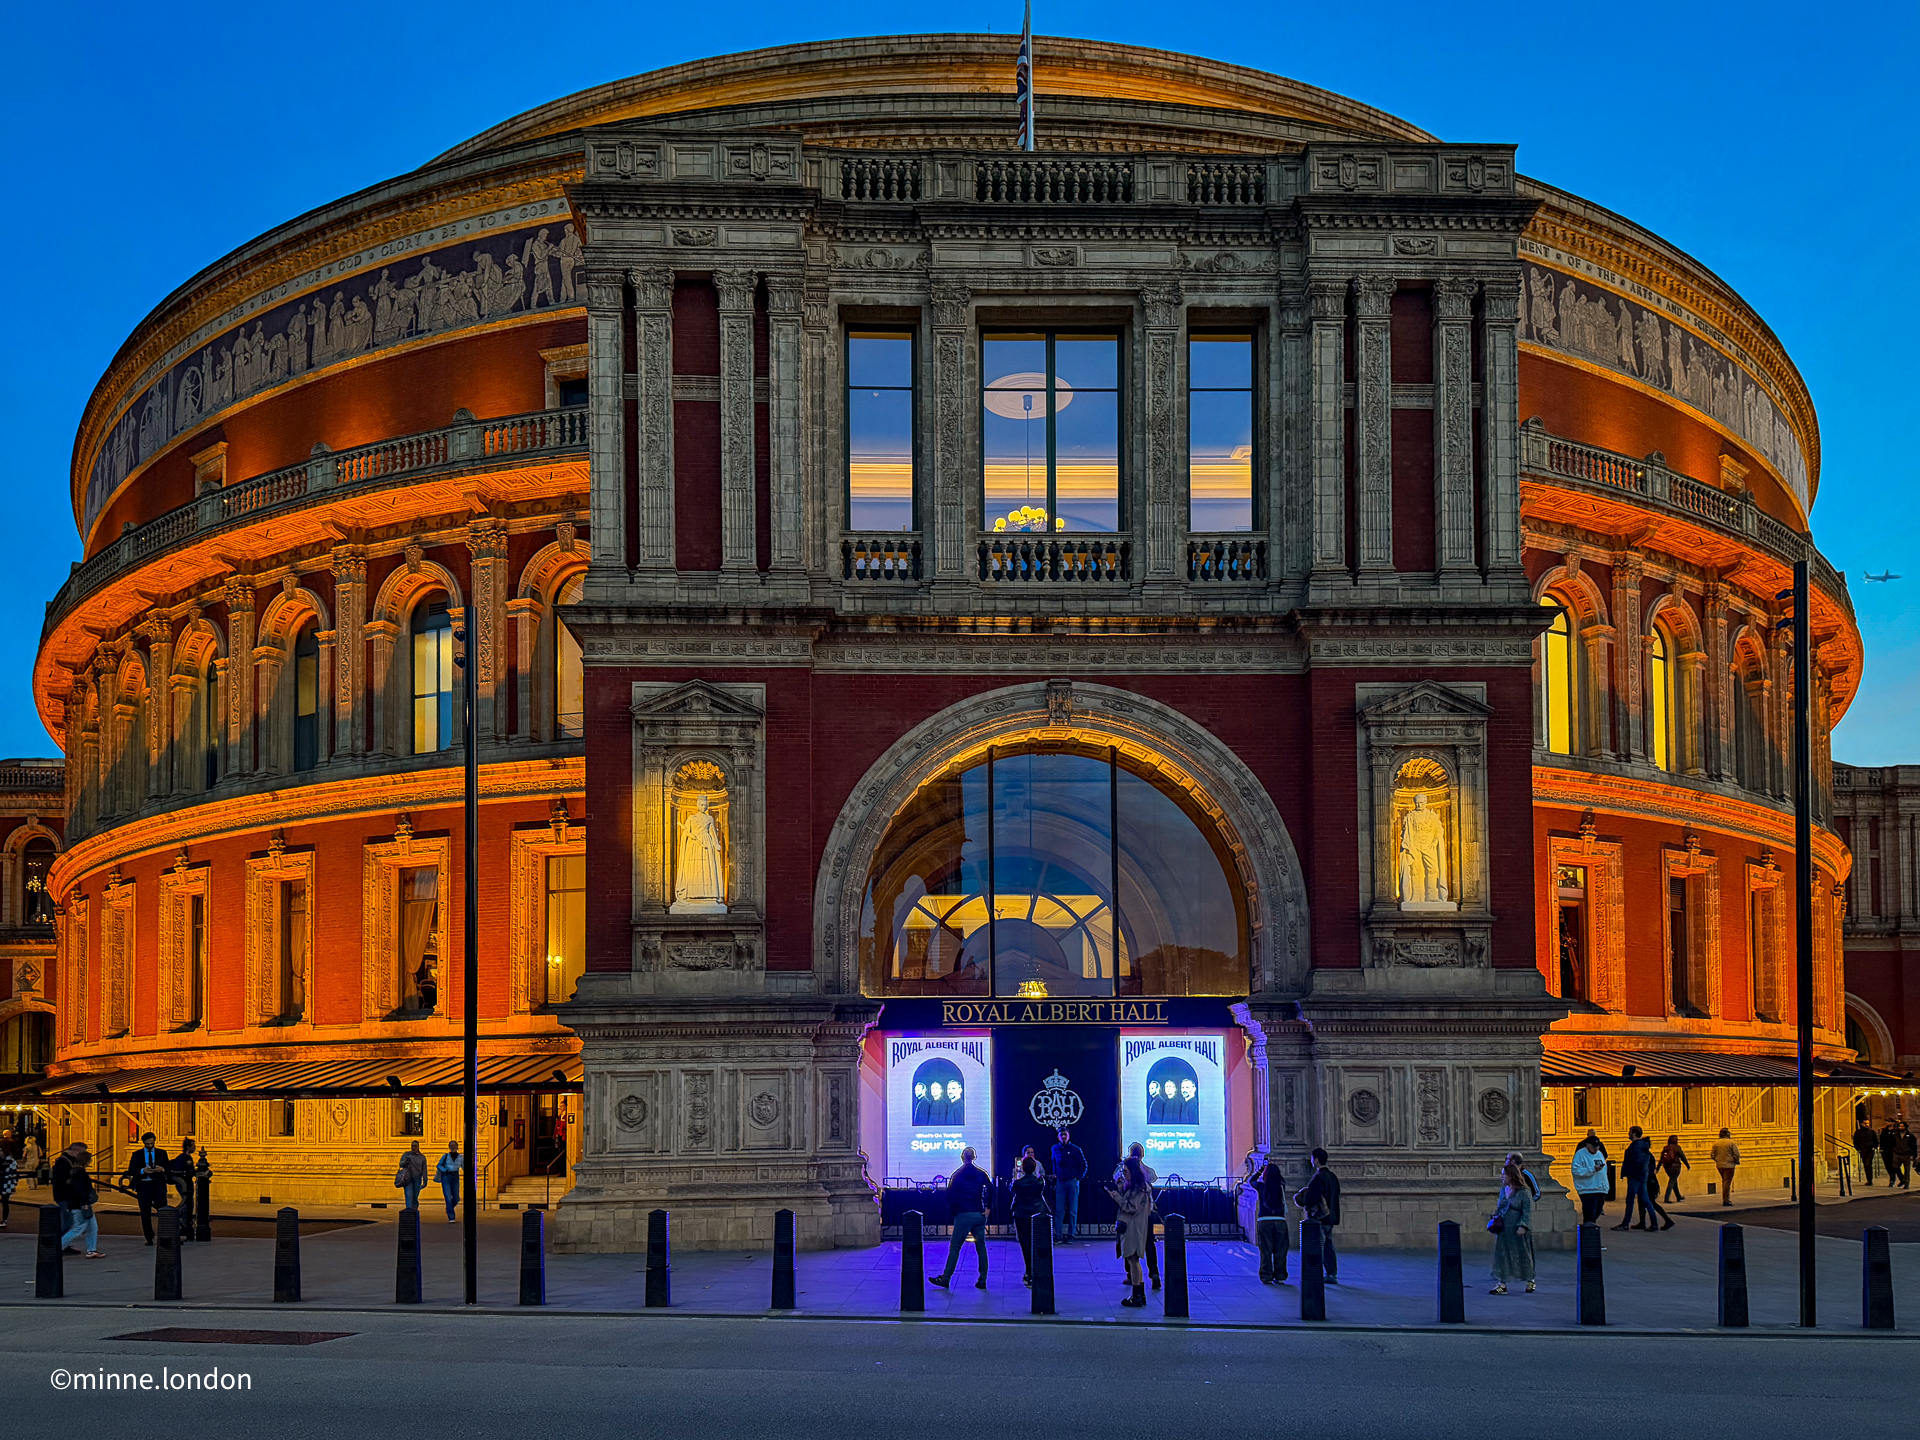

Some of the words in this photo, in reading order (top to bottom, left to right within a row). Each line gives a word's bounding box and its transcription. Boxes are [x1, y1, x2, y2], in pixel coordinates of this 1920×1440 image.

[227, 306, 244, 323] THE
[381, 234, 422, 257] GLORY
[442, 225, 457, 239] BE
[479, 215, 496, 229] TO
[519, 203, 549, 219] GOD
[1567, 255, 1581, 269] OF
[1597, 266, 1616, 284] THE
[1630, 283, 1653, 301] ARTS
[1666, 301, 1683, 318] AND
[1694, 318, 1725, 345] SCIENCES
[942, 1004, 1015, 1022] ROYAL
[1020, 1003, 1105, 1022] ALBERT
[1109, 1003, 1169, 1021] HALL
[892, 1042, 923, 1068] ROYAL
[925, 1042, 959, 1051] ALBERT
[961, 1042, 985, 1067] HALL
[1126, 1041, 1156, 1067] ROYAL
[1158, 1041, 1192, 1050] ALBERT
[1194, 1041, 1218, 1067] HALL
[911, 1140, 942, 1152] Sigur
[944, 1139, 966, 1150] Rós
[1146, 1139, 1177, 1151] Sigur
[1178, 1138, 1201, 1149] Rós
